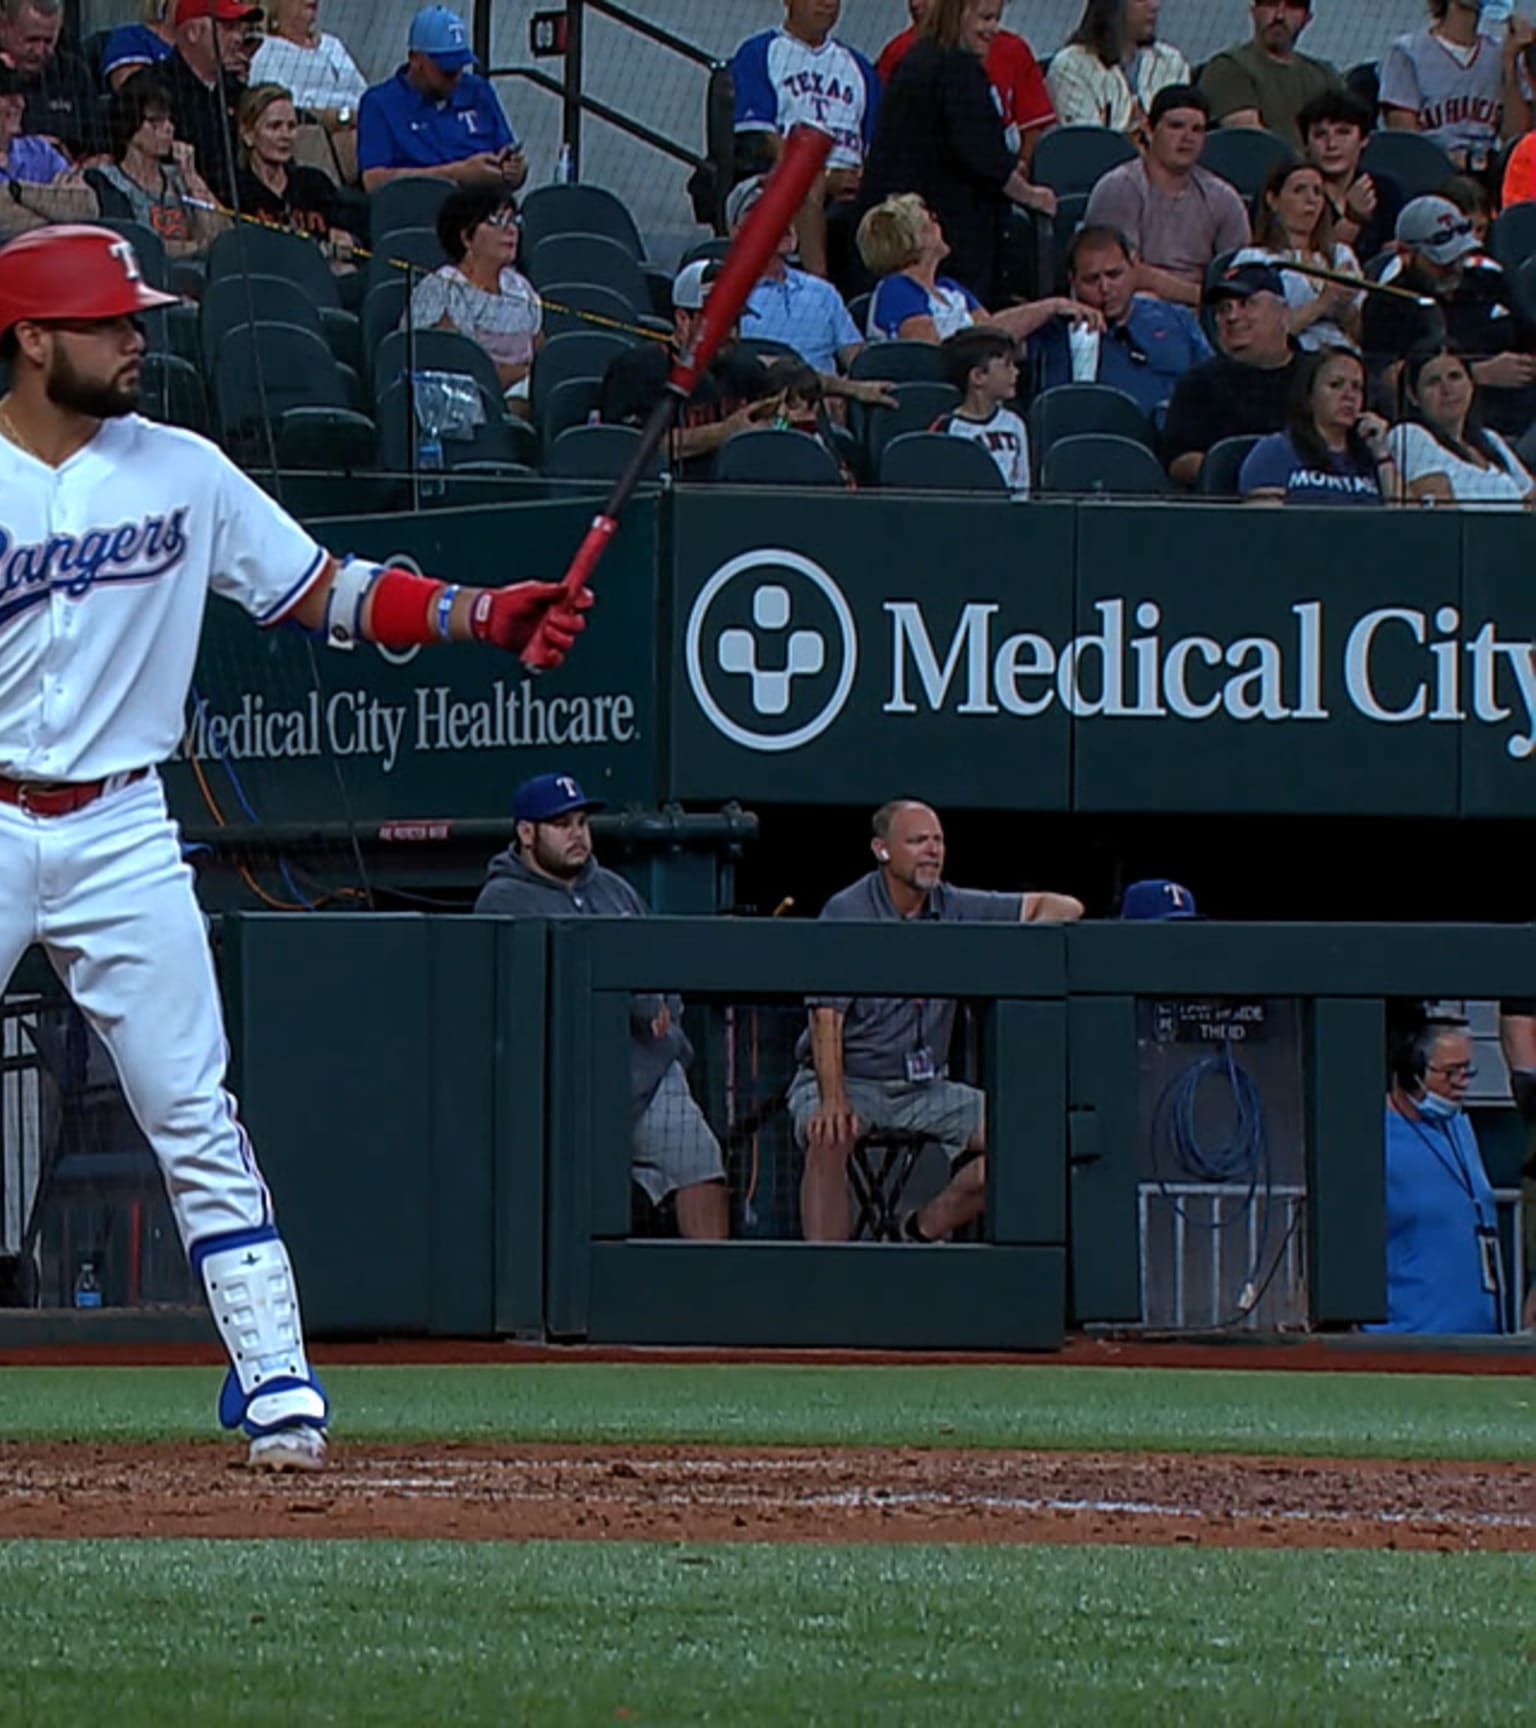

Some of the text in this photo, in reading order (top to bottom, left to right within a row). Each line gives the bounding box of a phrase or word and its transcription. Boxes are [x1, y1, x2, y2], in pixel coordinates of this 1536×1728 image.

[783, 69, 855, 105] TEXAS
[108, 241, 140, 279] T
[882, 597, 1330, 722] Medical
[326, 690, 406, 772] City
[414, 679, 635, 752] Healthcare
